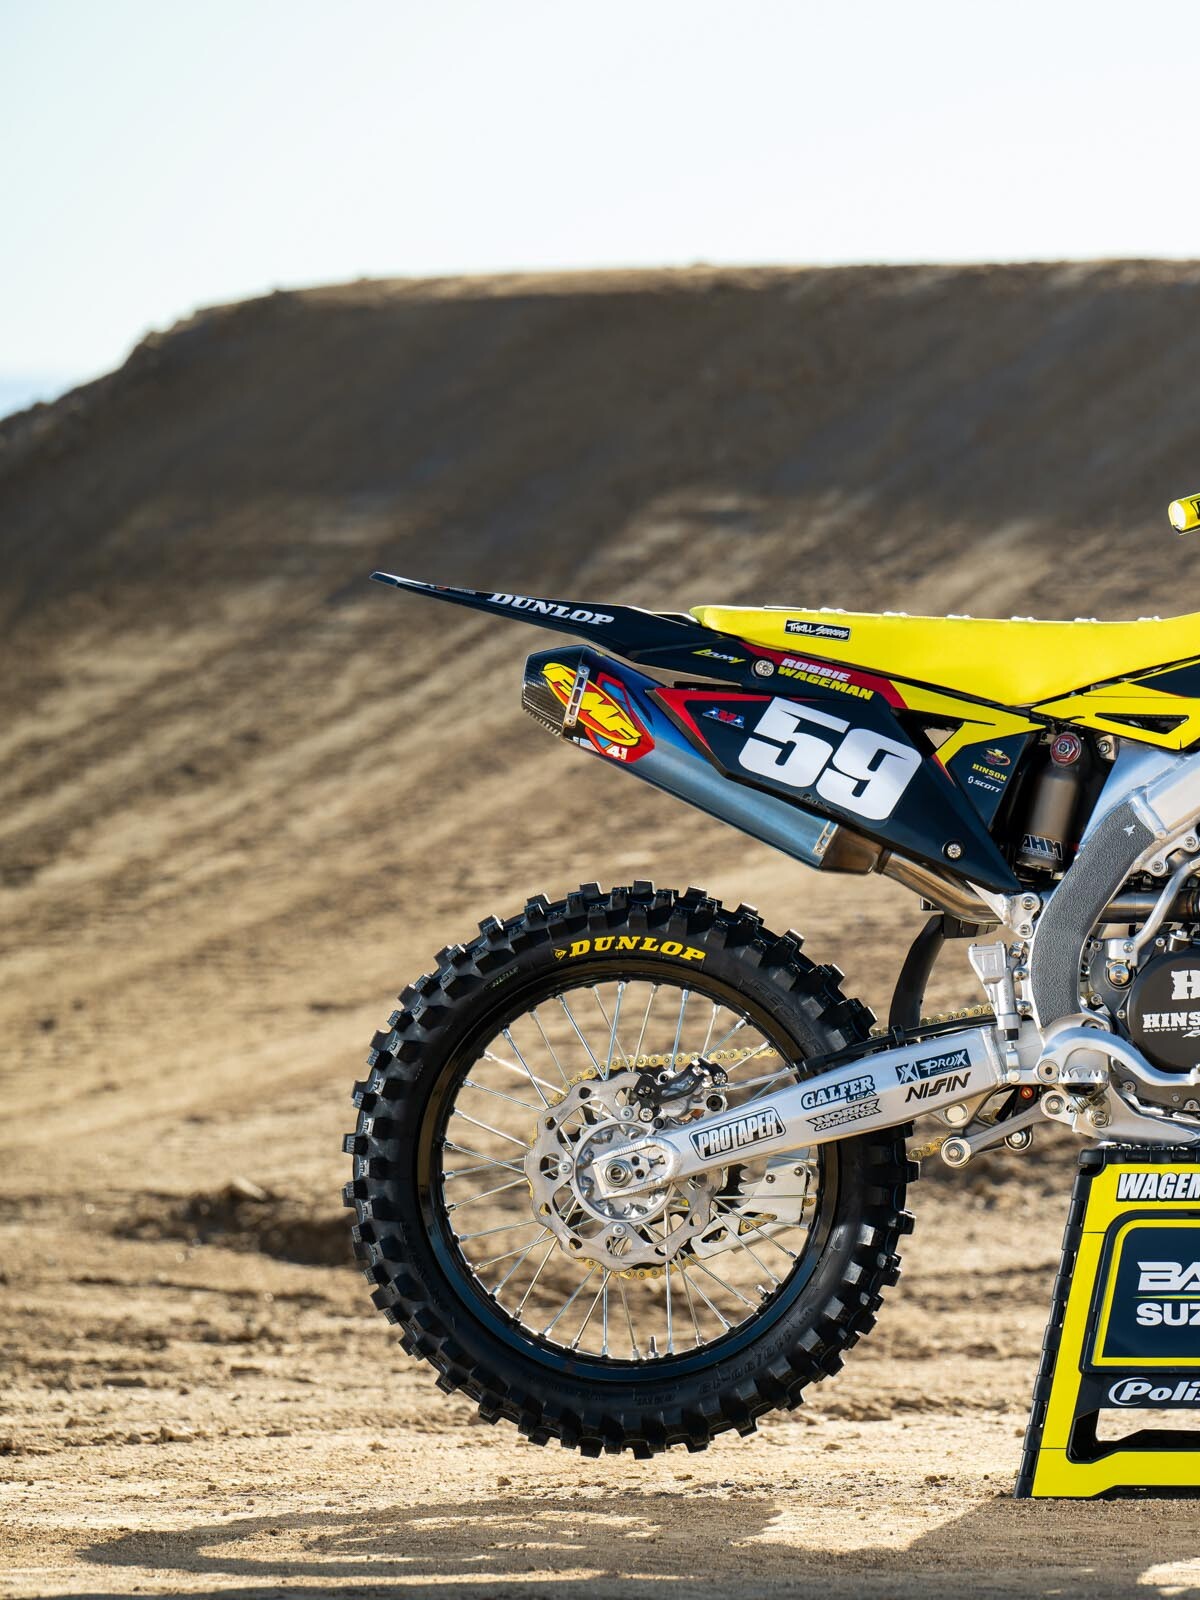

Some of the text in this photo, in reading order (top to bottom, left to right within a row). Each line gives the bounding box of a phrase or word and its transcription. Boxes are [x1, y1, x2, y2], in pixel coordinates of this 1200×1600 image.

[487, 593, 615, 625] DUNLOP
[777, 666, 875, 700] WAGEMAN
[782, 658, 852, 682] ROBBIE
[541, 664, 643, 741] FMF
[738, 696, 923, 821] 59
[972, 763, 1008, 782] HINSON
[973, 779, 1002, 793] SCOTT
[569, 936, 706, 961] DUNLOP
[801, 1077, 875, 1108] GALFER
[848, 1090, 877, 1102] USA
[905, 1071, 971, 1103] NISSIN
[808, 1100, 879, 1126] WORKS
[815, 1108, 882, 1132] CONNECTION
[697, 1112, 778, 1159] PROTAPER
